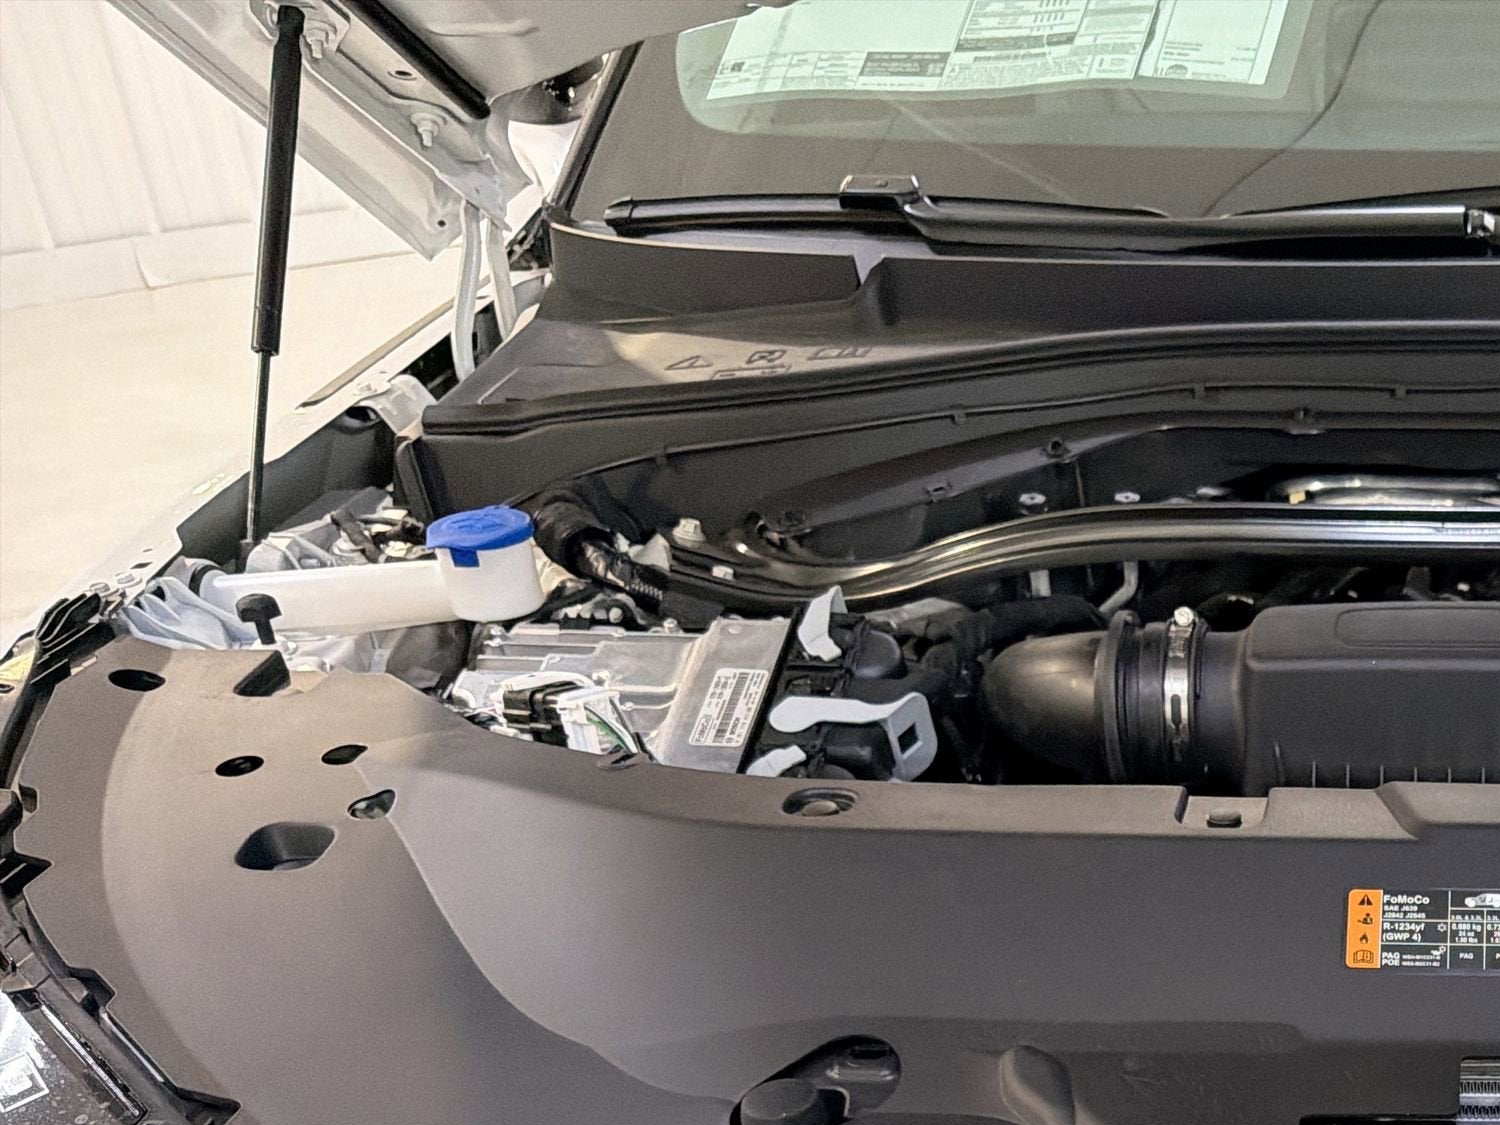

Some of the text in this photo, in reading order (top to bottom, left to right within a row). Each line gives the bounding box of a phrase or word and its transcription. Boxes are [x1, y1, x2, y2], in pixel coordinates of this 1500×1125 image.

[1383, 894, 1430, 904] FoMoCo
[1383, 923, 1425, 932] R-1234yf
[1472, 923, 1481, 932] kg
[1382, 932, 1422, 942] (GWP 4)
[1382, 952, 1400, 960] PAG
